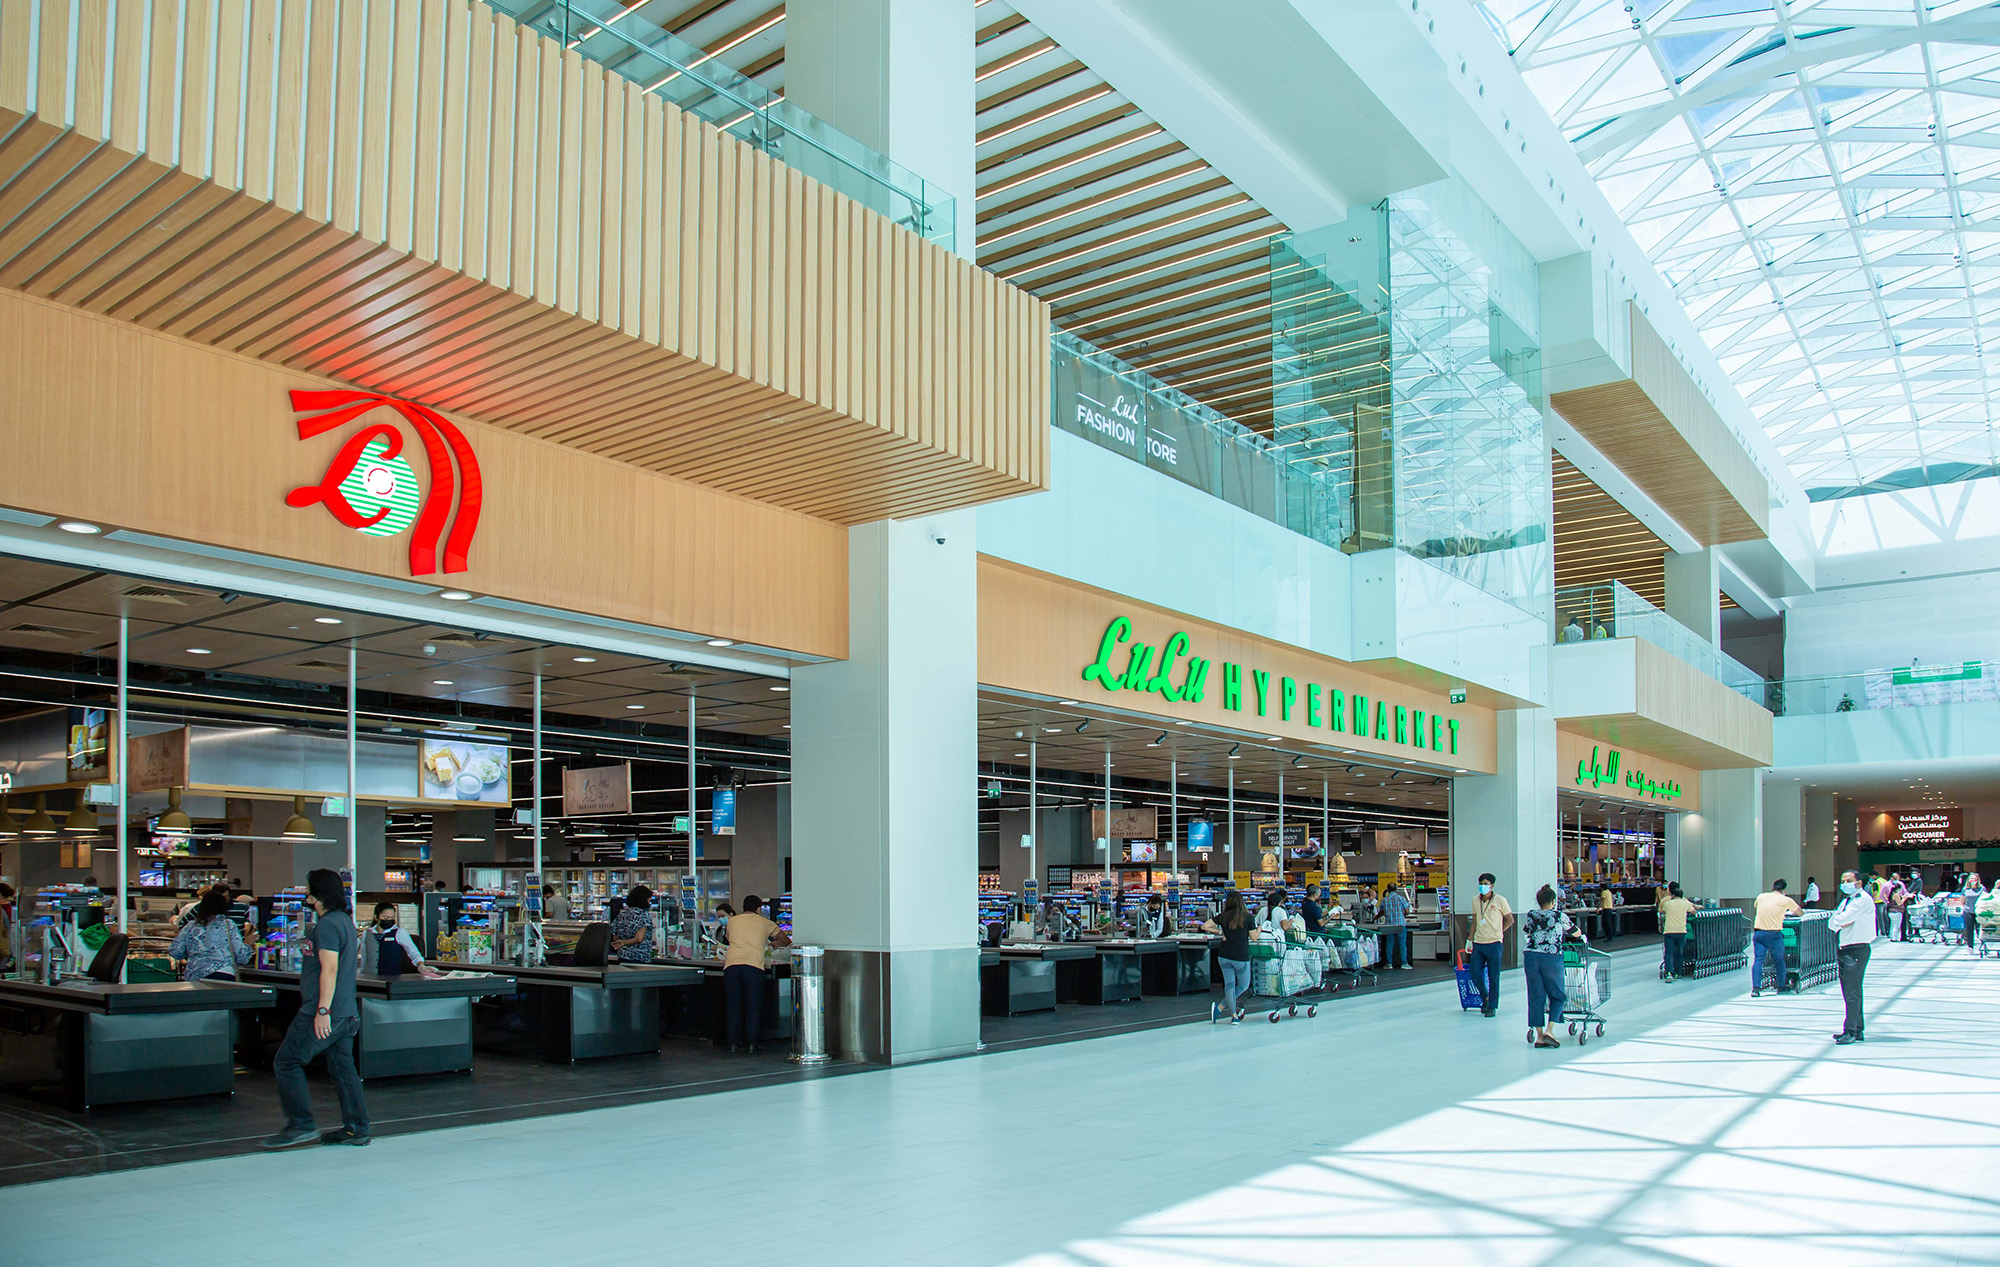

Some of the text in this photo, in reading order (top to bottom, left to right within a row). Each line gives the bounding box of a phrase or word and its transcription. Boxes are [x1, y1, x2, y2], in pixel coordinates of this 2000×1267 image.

[1111, 394, 1147, 425] LuL
[1077, 404, 1177, 465] FASHION TORE
[1081, 615, 1460, 756] LuLu HYPERMARKET
[1902, 831, 1946, 839] CONSUMER
